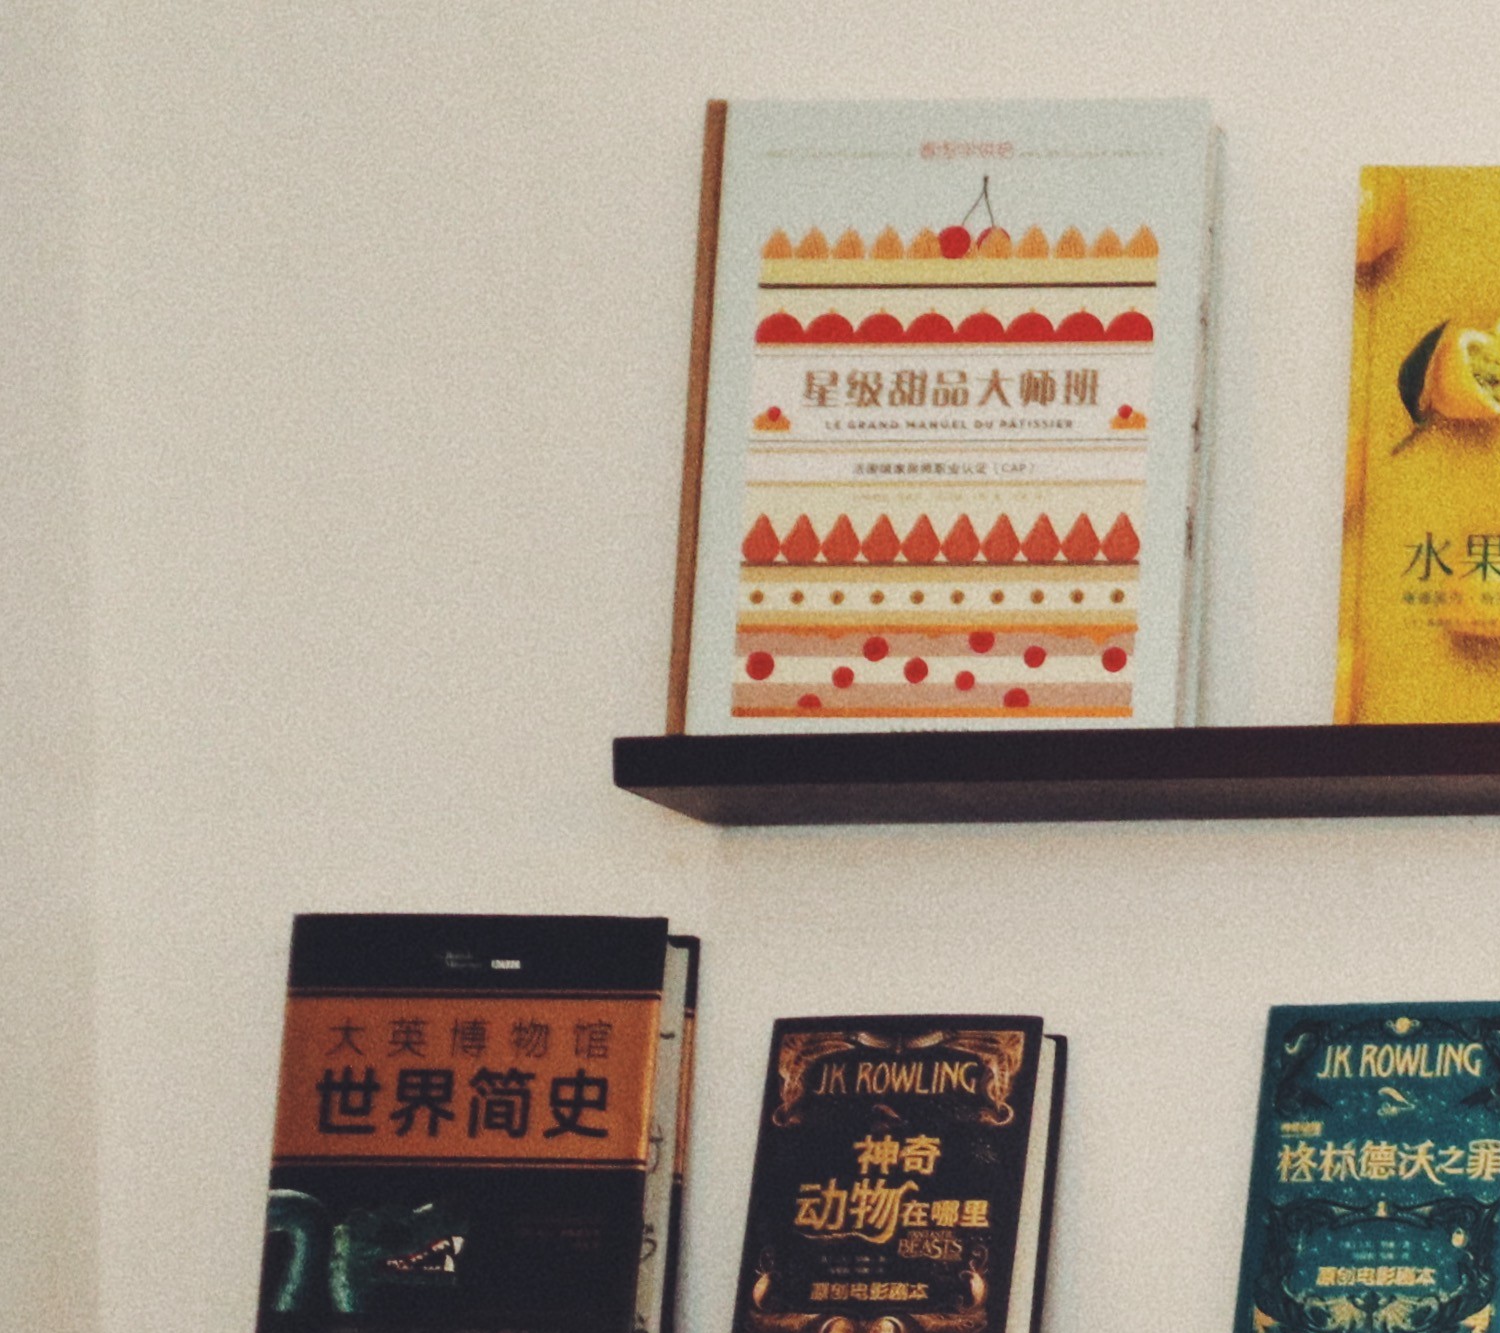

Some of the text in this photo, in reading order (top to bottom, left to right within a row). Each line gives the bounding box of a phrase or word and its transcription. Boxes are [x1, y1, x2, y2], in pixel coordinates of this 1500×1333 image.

[803, 368, 1099, 407] 星级甜品大师班
[329, 1018, 614, 1060] 大英博物馆
[856, 1060, 979, 1094] ROWLING
[1360, 1043, 1484, 1078] ROWLING
[315, 1067, 610, 1139] 世界简史
[854, 1134, 941, 1175] 神奇
[794, 1178, 990, 1244] 动物 在哪里
